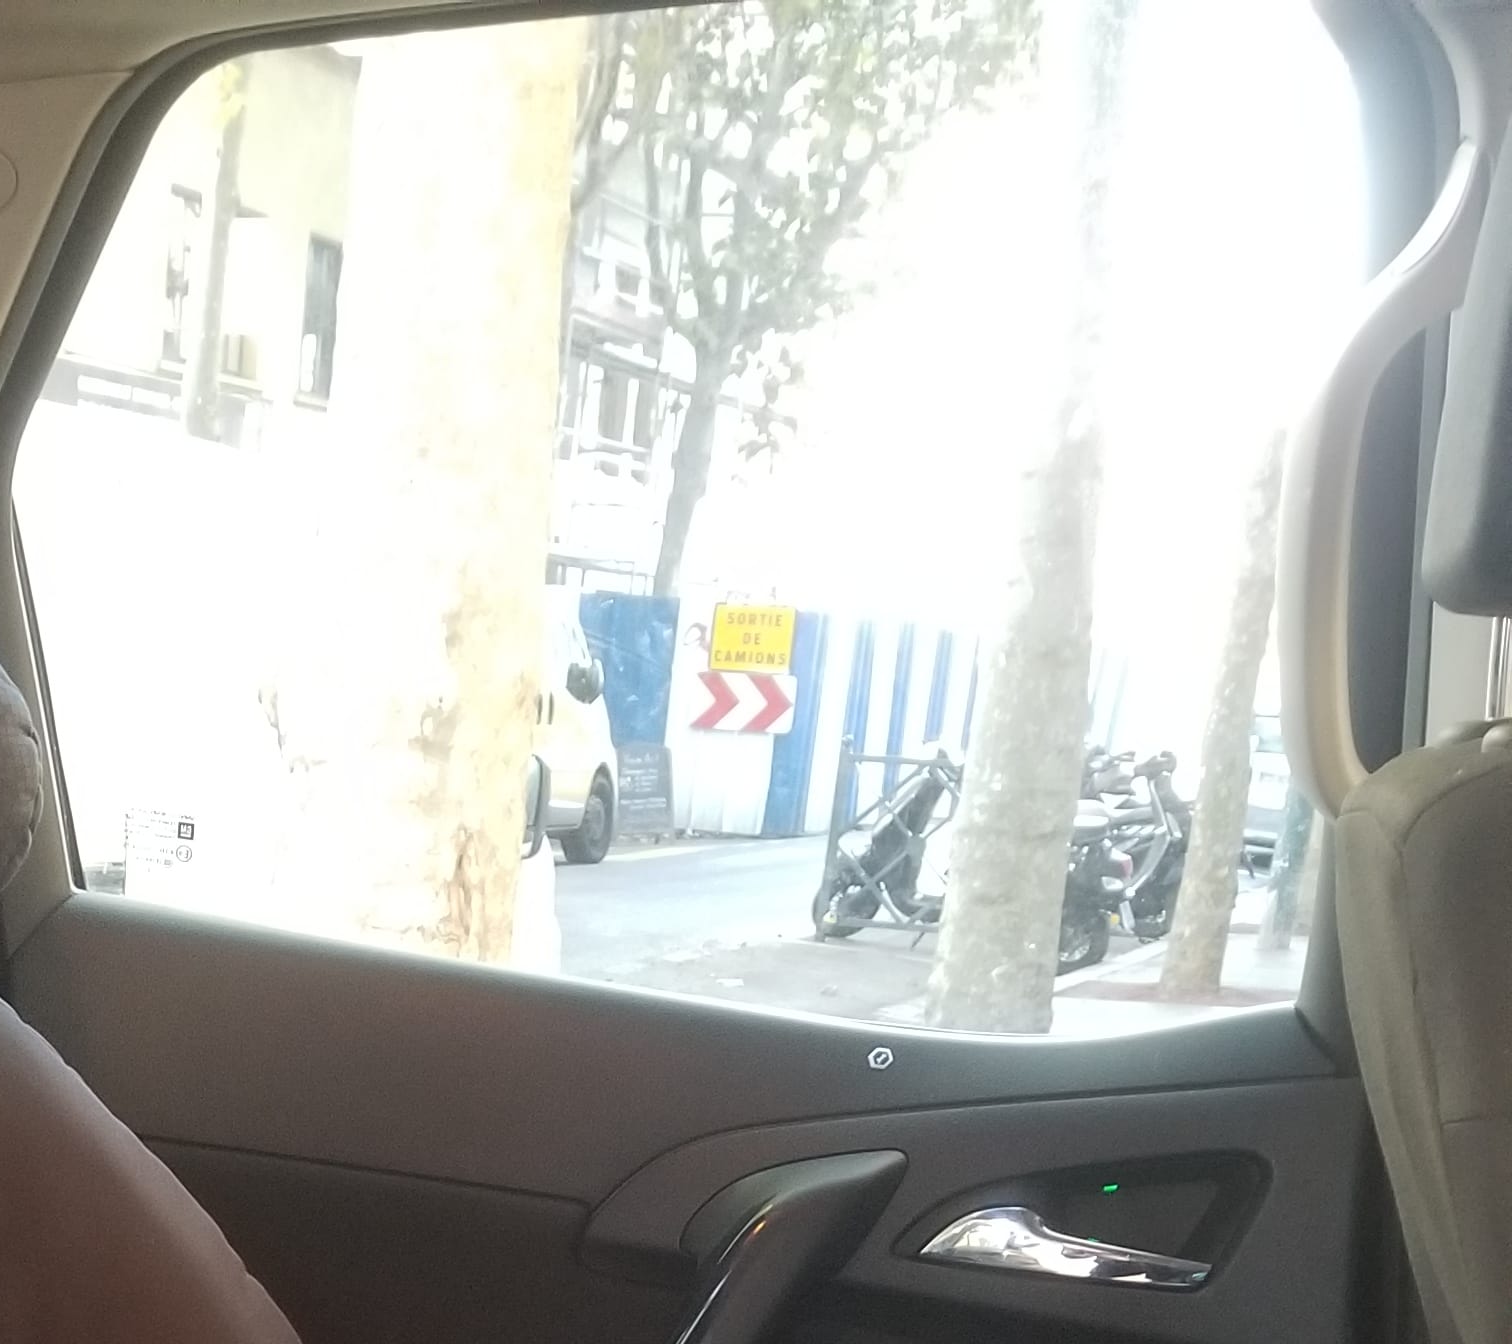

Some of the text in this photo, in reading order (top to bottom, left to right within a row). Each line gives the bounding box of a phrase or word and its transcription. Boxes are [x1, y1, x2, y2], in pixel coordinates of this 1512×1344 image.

[727, 612, 783, 627] SORTIE
[743, 632, 761, 645] DE
[714, 650, 787, 665] CAMIONS
